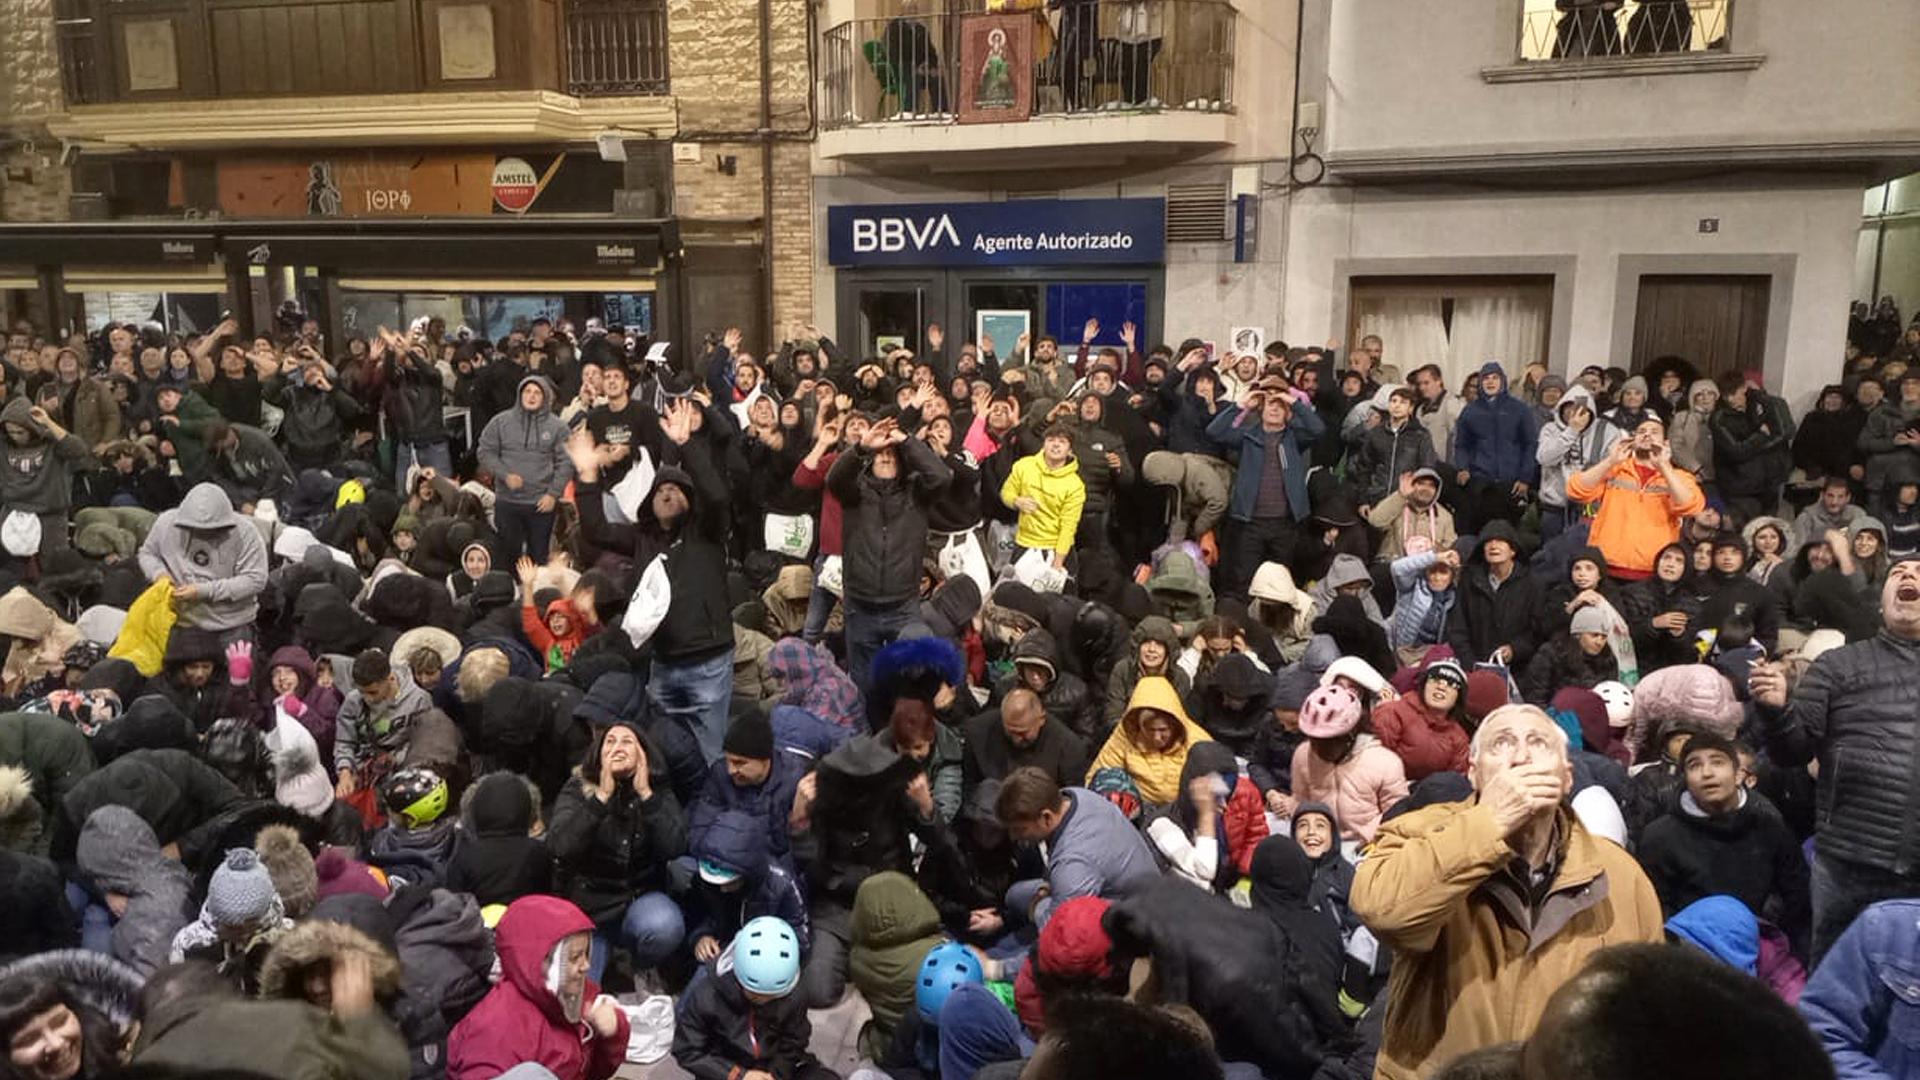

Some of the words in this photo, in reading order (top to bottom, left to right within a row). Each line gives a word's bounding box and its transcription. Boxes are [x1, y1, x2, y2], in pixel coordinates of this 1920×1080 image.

[495, 173, 533, 185] AMSTEL
[853, 214, 961, 252] BBVA
[973, 233, 1033, 254] Agente
[1036, 231, 1133, 250] Autorizado
